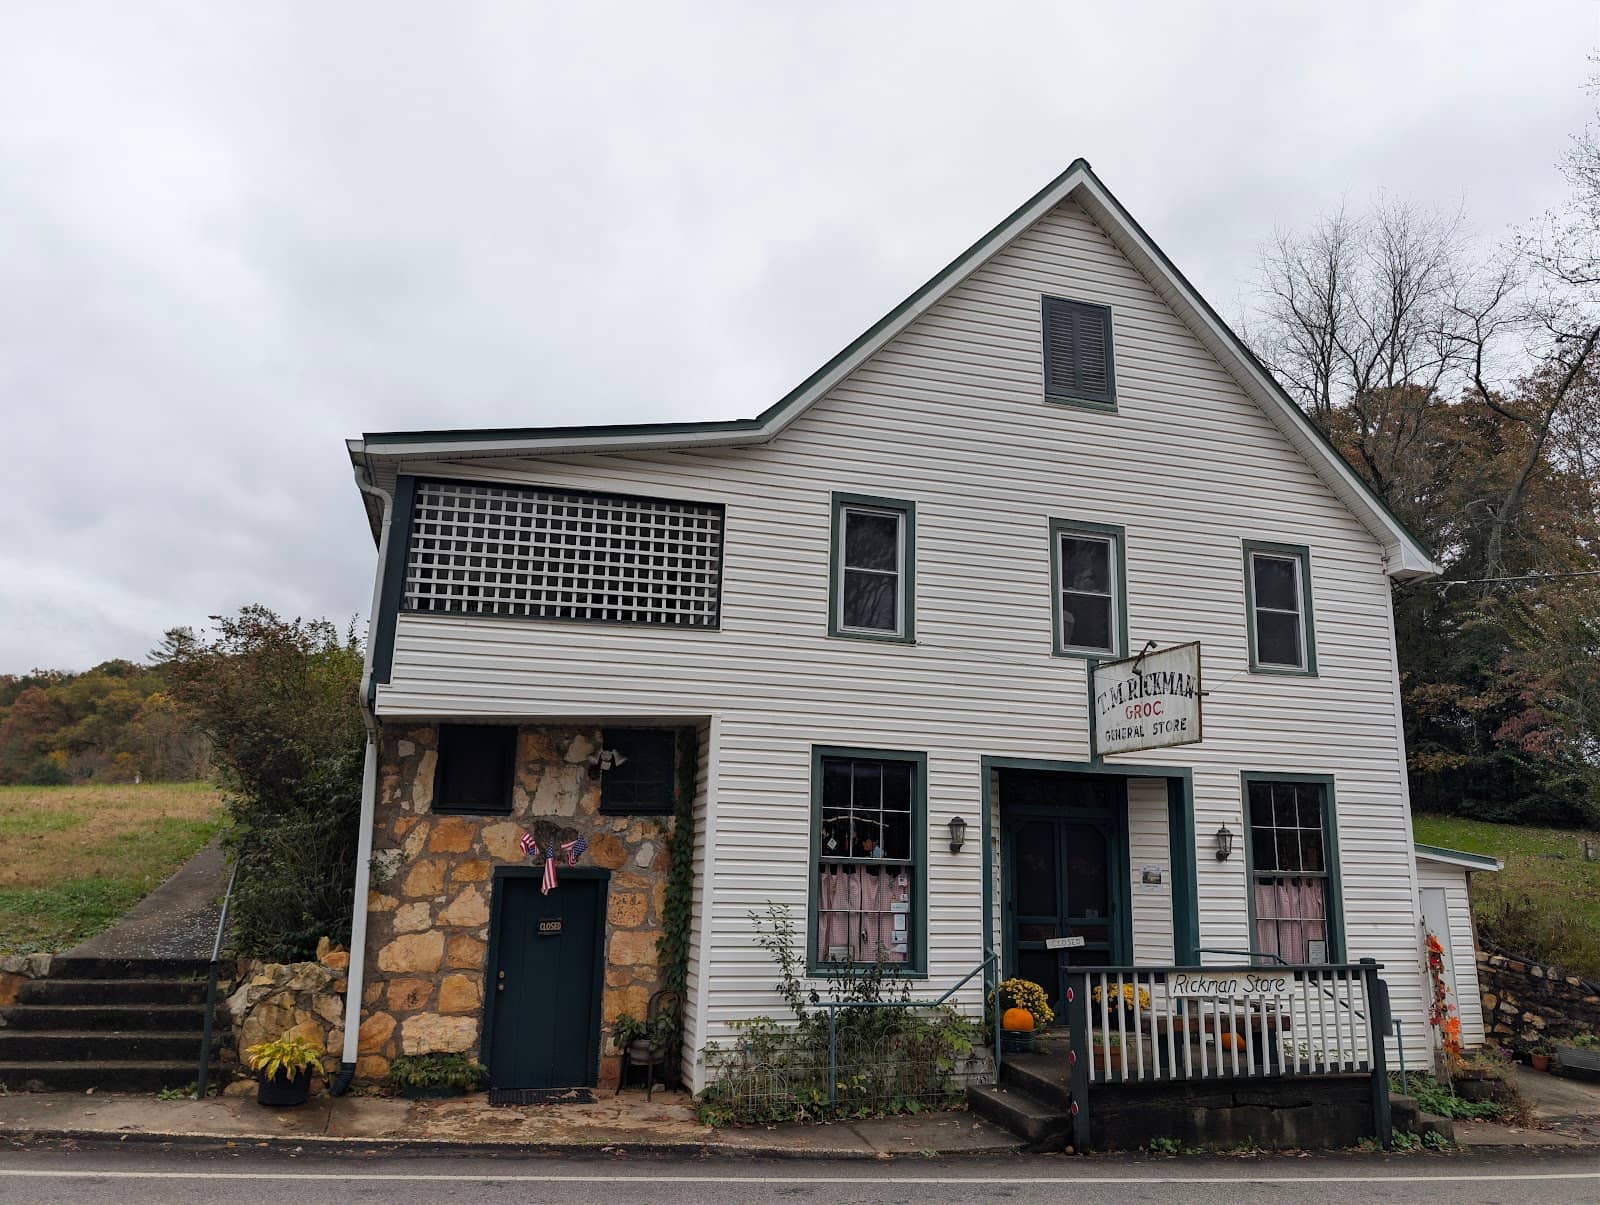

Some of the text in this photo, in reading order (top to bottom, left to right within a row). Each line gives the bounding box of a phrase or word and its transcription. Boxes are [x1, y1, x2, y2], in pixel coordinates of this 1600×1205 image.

[1127, 671, 1196, 699] RICKMAN
[1126, 701, 1164, 720] GROC.
[1105, 718, 1187, 742] GENERAL STORE
[539, 921, 562, 931] CLOSED
[1173, 974, 1286, 994] Rickman Store
